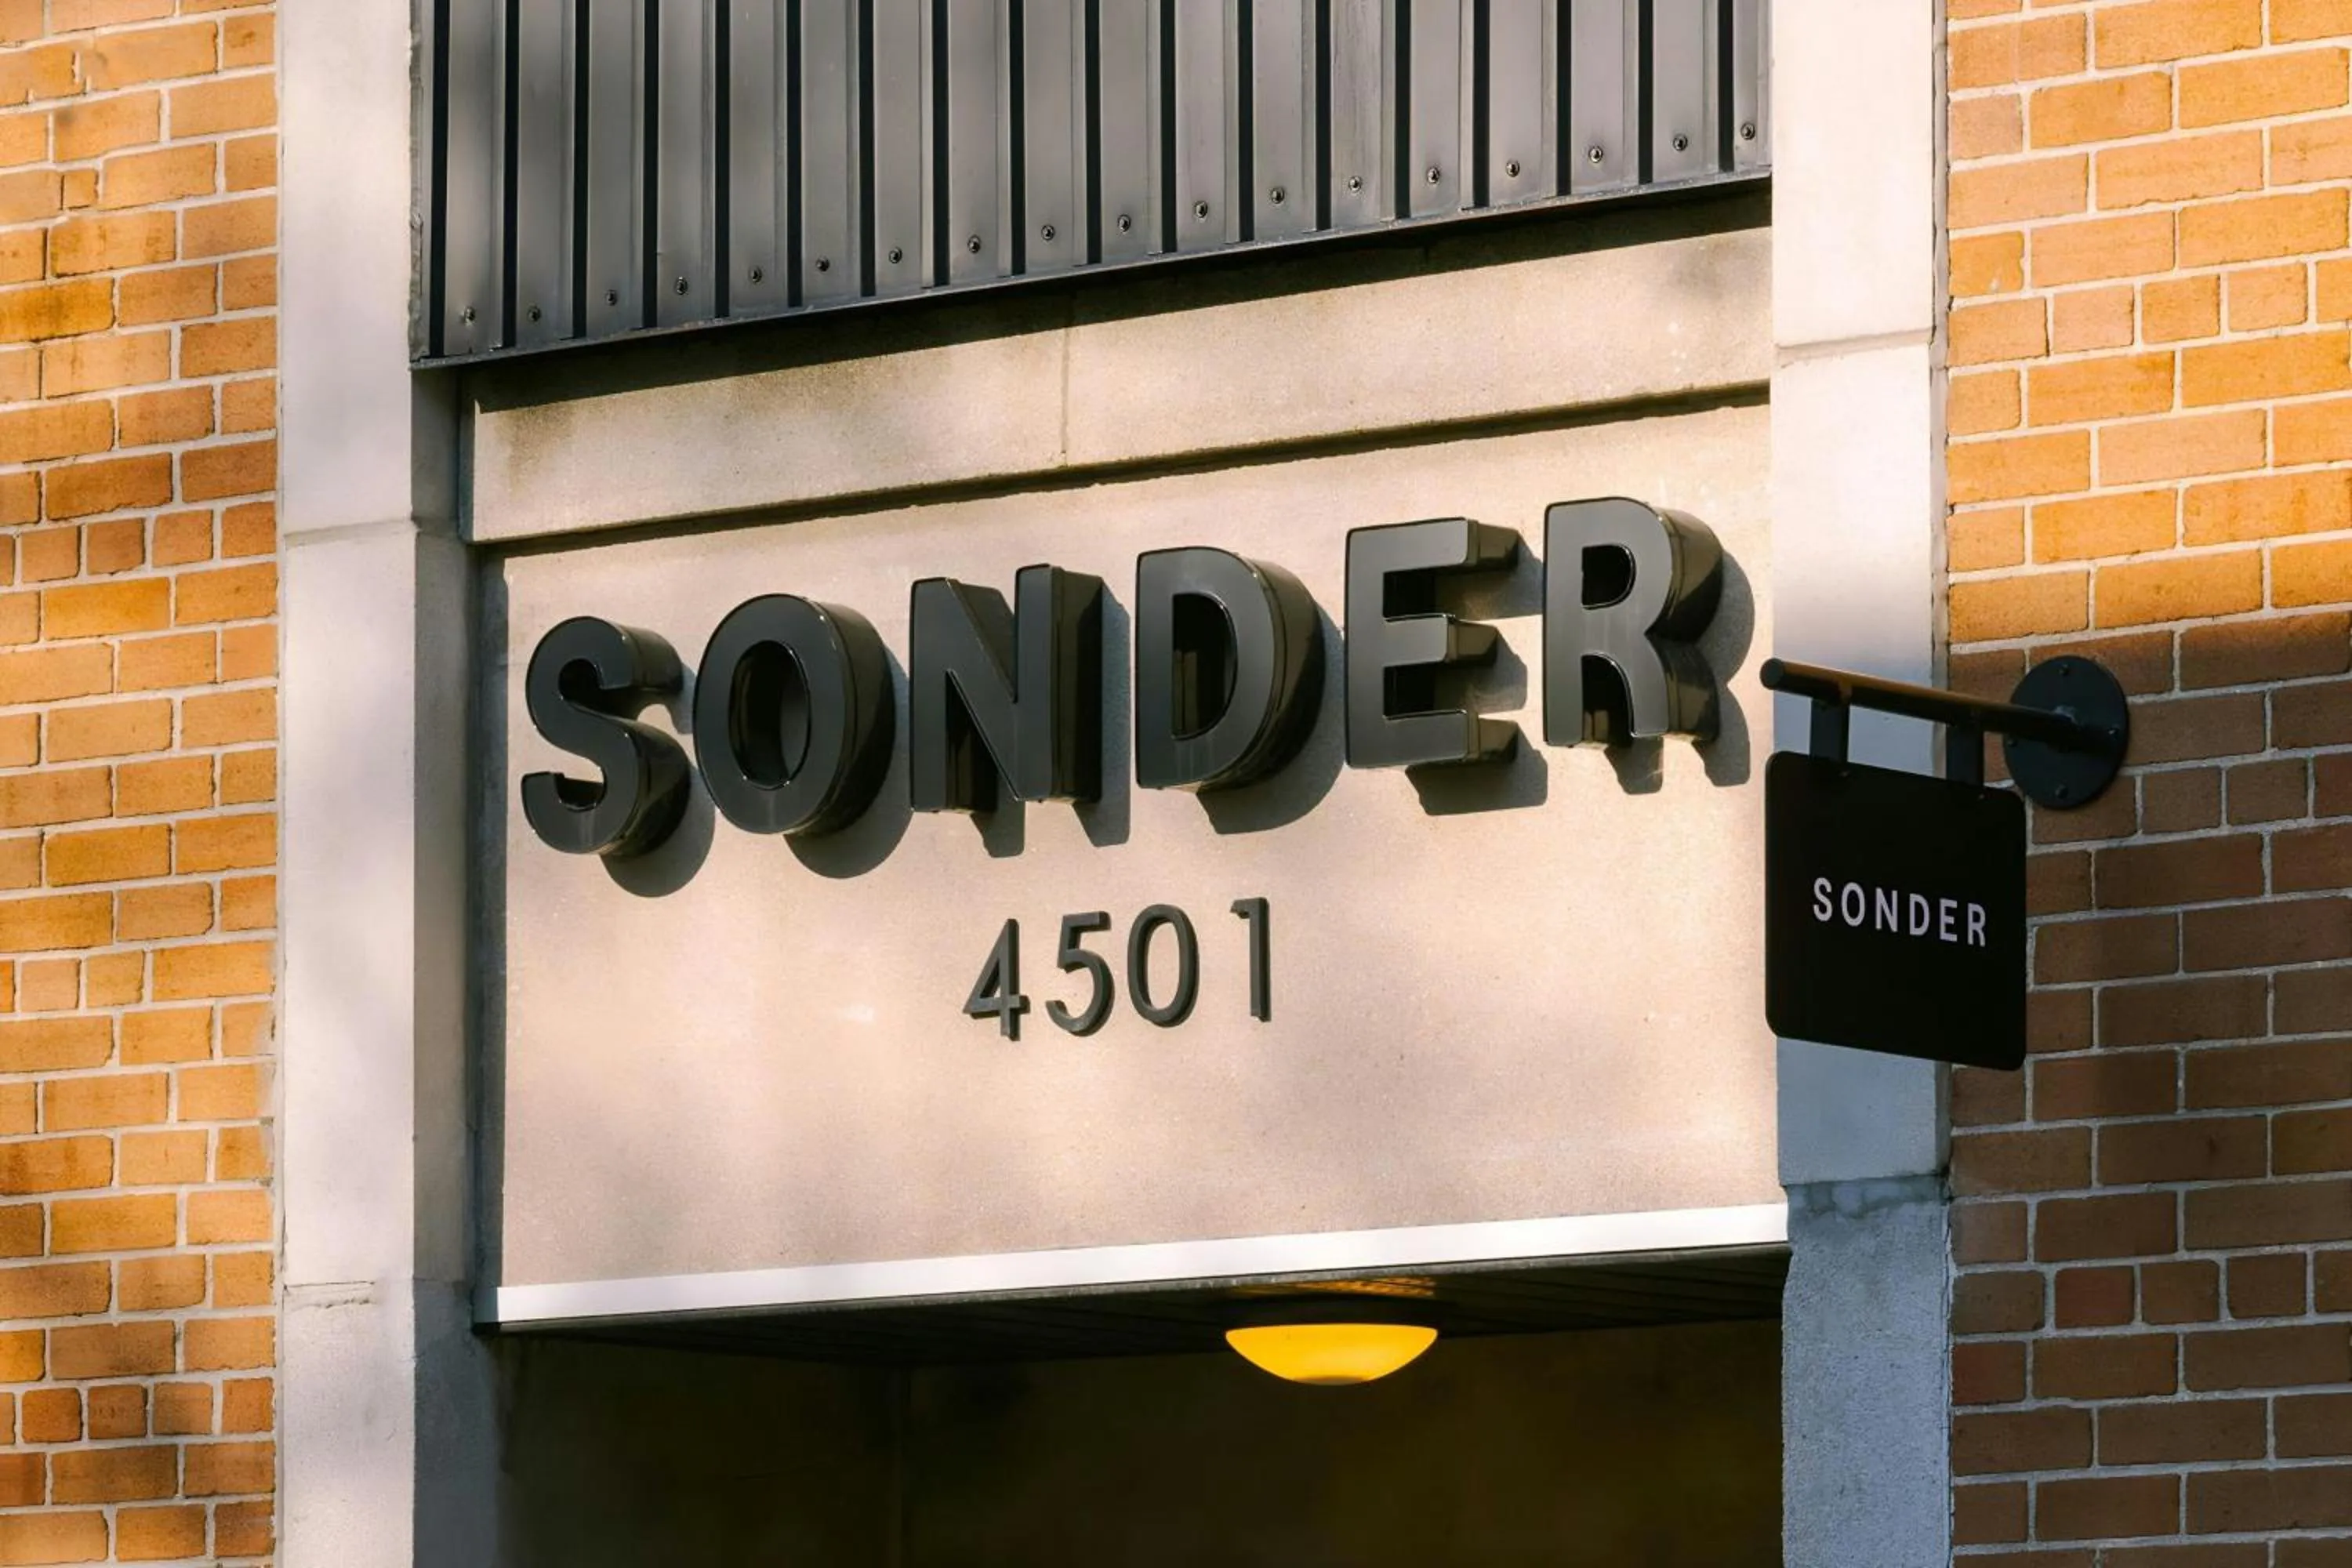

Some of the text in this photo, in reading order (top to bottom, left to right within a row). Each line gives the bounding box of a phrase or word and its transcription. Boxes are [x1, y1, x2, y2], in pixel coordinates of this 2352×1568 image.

[521, 495, 1722, 856] SONDER
[962, 896, 1272, 1042] 4501
[1813, 877, 1987, 947] SONDER
